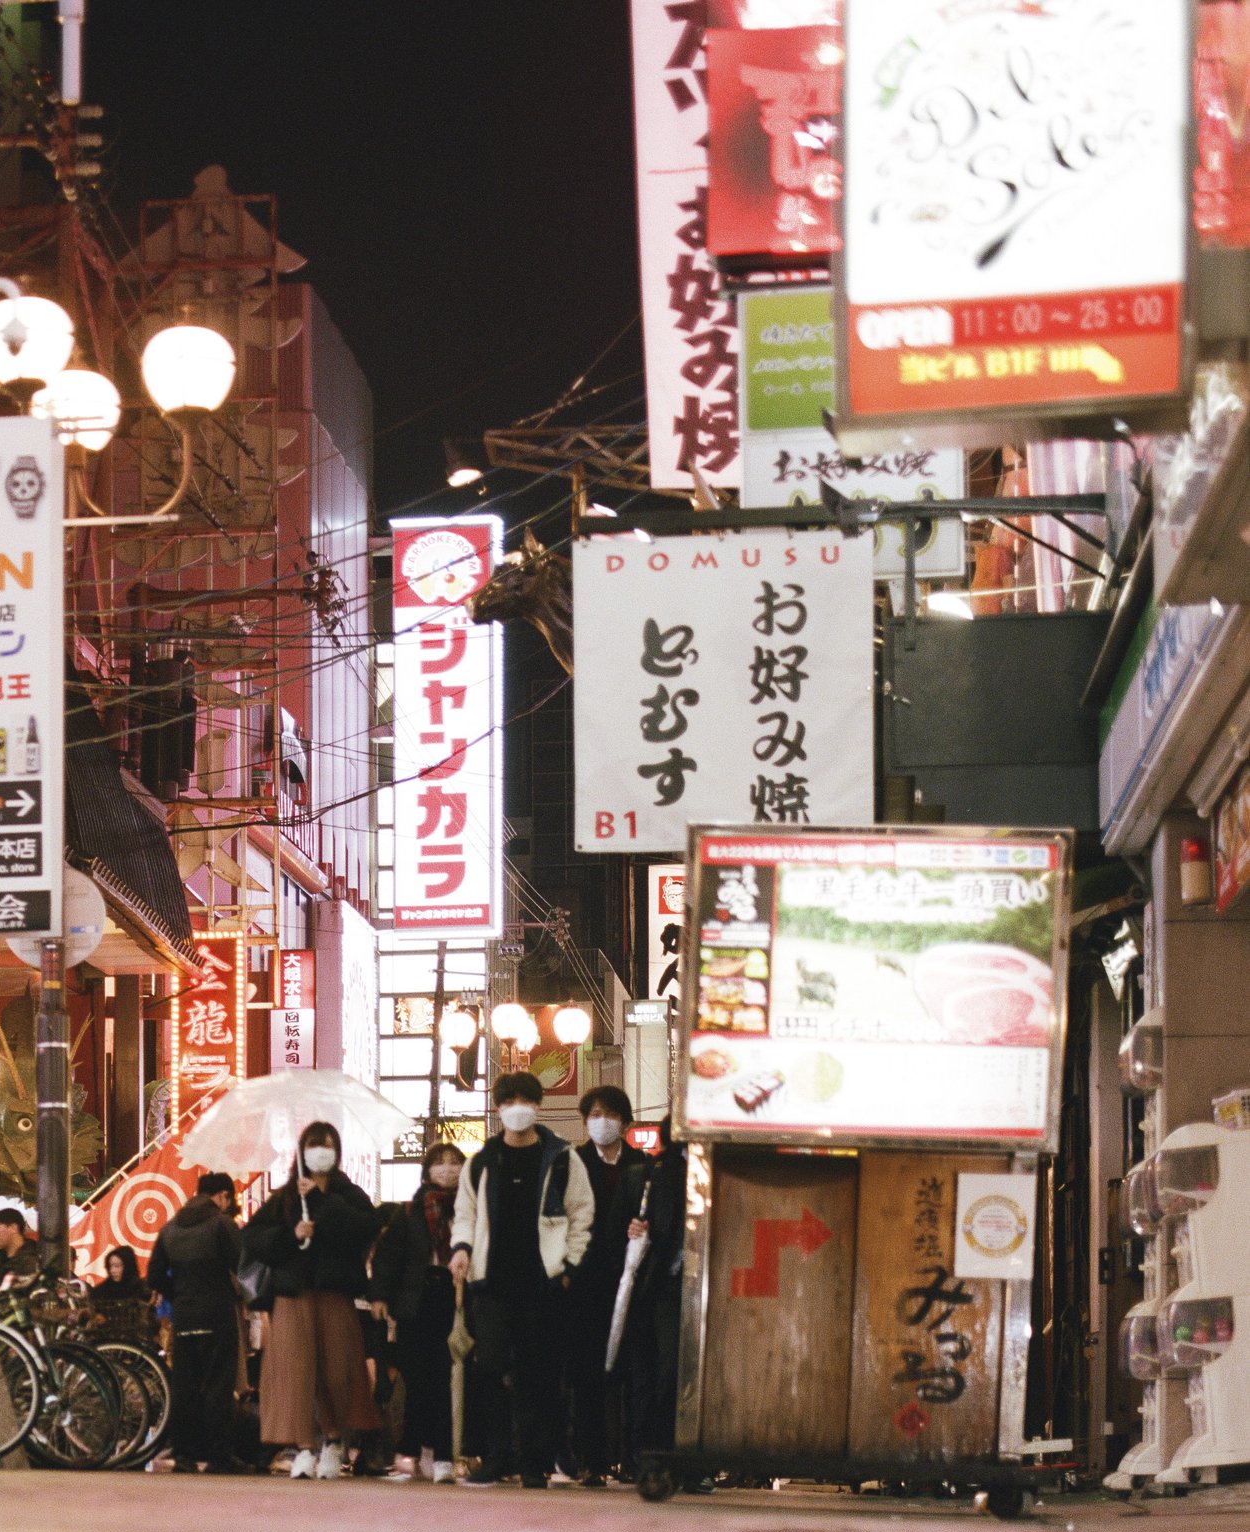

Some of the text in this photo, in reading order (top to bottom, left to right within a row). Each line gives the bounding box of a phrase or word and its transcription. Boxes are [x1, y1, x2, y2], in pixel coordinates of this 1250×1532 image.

[856, 306, 955, 350] OPEN
[985, 347, 1042, 380] B1F
[772, 450, 938, 485] お好み焼
[605, 545, 841, 573] DOMUSU
[636, 616, 700, 807] どむす
[748, 579, 810, 824] お好み焼
[416, 616, 468, 900] ジャンカラ
[594, 810, 637, 840] B1
[10, 862, 36, 873] store
[283, 1010, 301, 1066] 回転寿司
